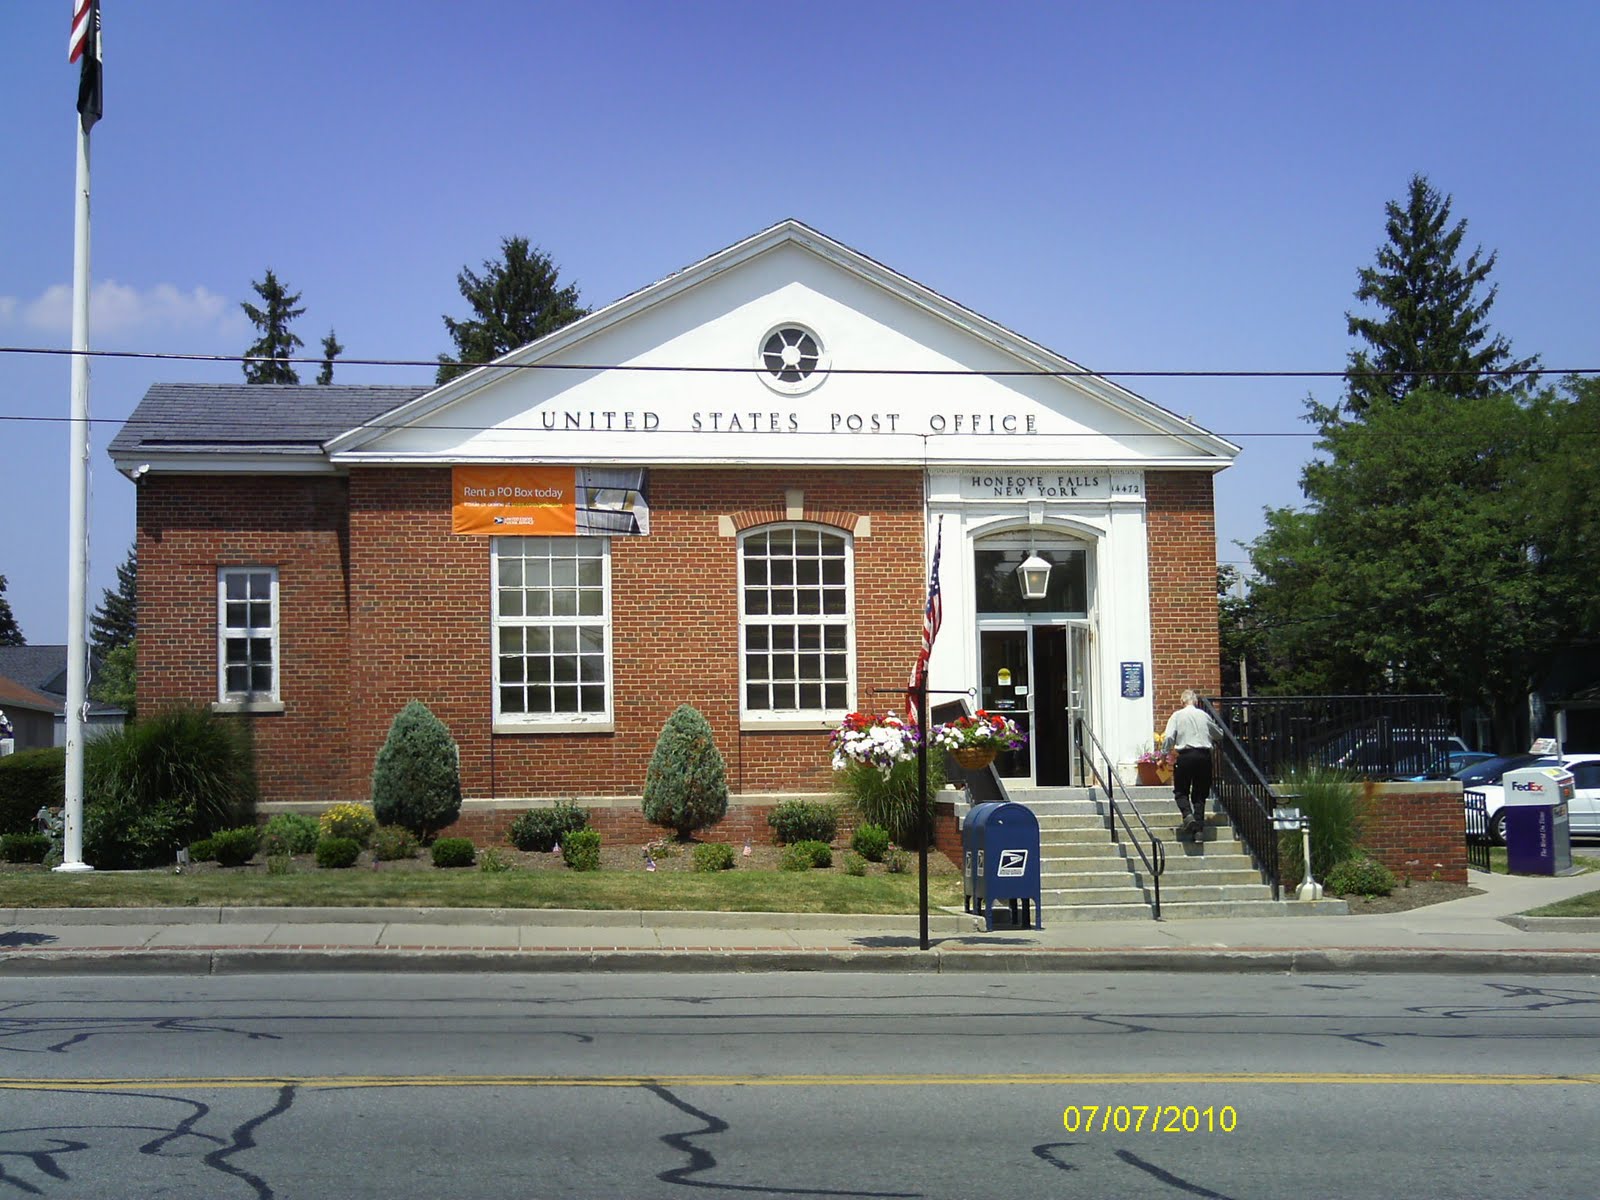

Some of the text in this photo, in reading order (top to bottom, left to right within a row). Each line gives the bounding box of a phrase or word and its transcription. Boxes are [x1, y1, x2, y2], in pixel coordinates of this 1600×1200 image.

[541, 411, 1038, 434] UNITED STATES POST OFFICE
[971, 476, 1100, 487] HONEOYE FALLS
[464, 487, 563, 499] Rent a PO Box today
[994, 487, 1079, 497] NEW YORK
[1512, 782, 1544, 791] FedEx
